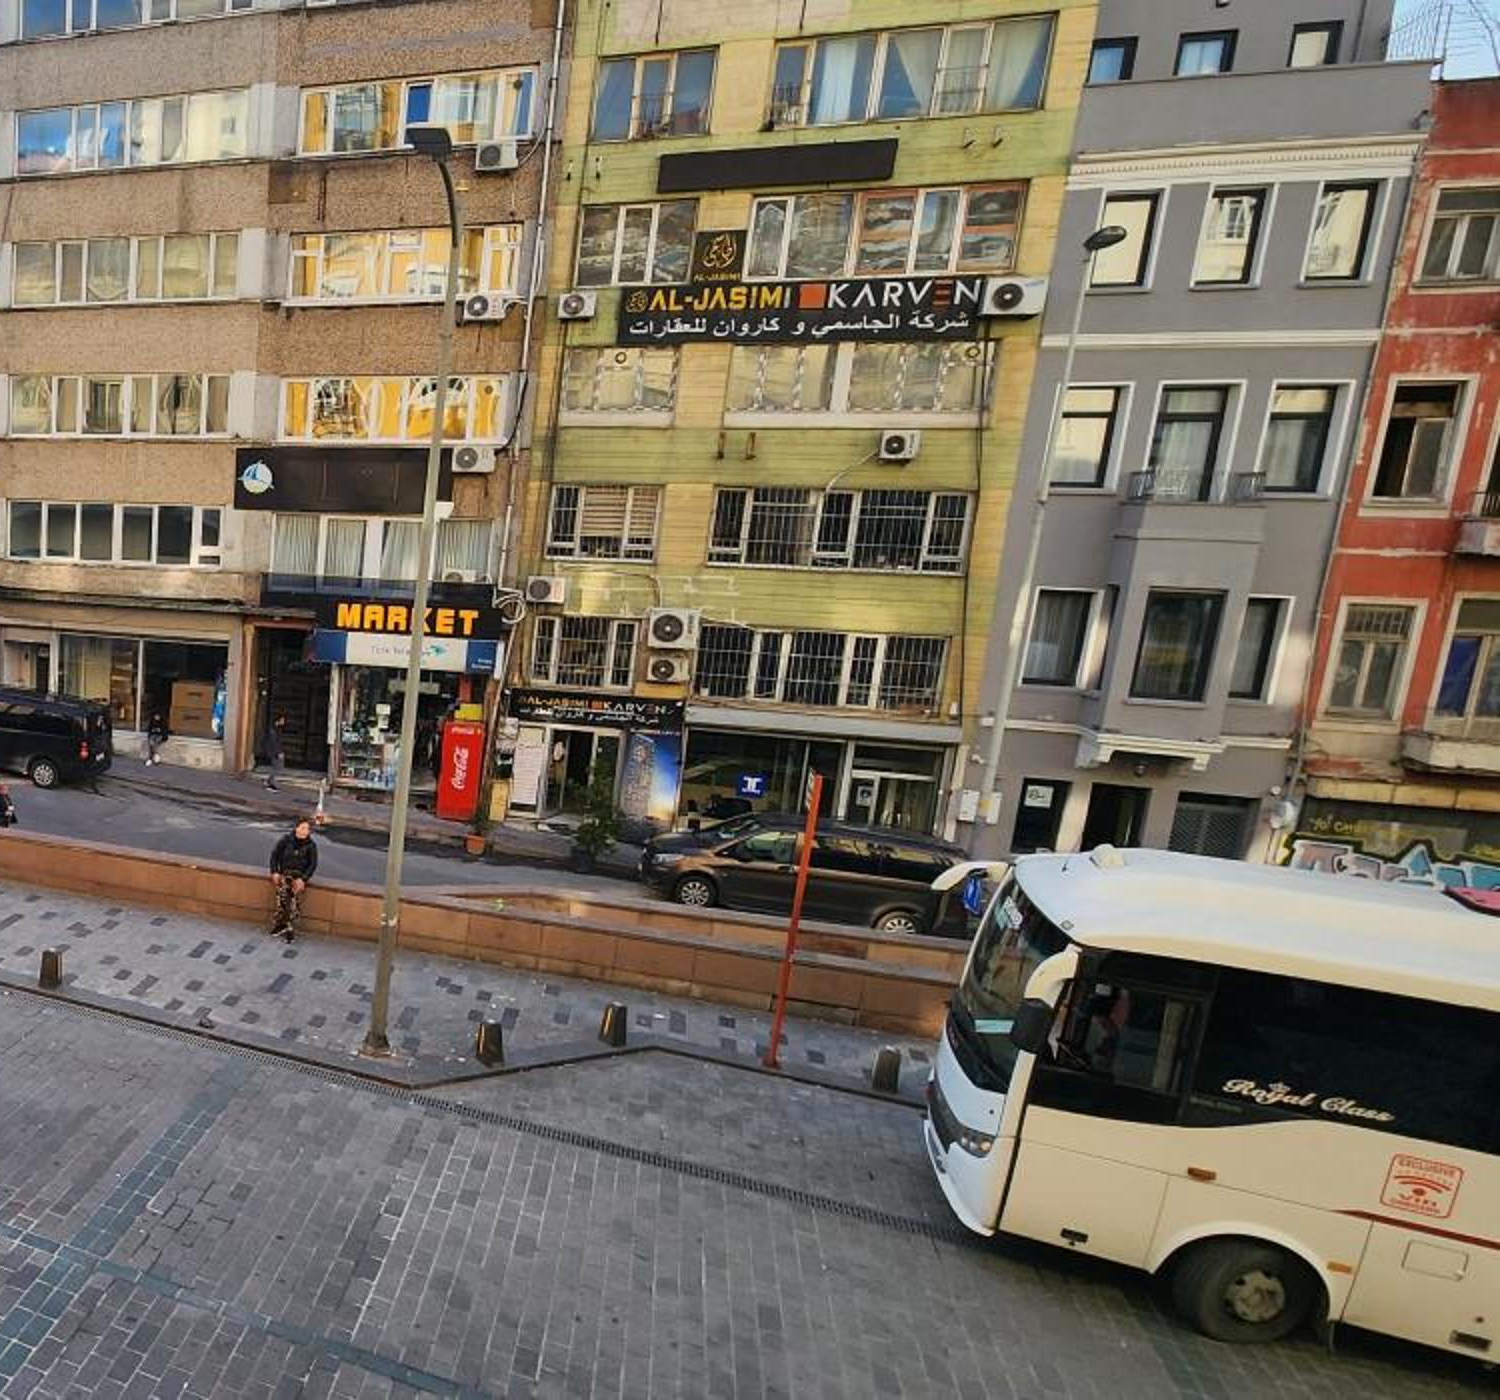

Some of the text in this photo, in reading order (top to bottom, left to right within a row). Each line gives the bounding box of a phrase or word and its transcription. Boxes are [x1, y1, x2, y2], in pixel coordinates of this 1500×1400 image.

[649, 279, 982, 312] AL-JASIMI KARVEN
[629, 309, 970, 339] شركة الجاسمي و كاروان للعقارات
[336, 603, 480, 636] MARKET
[603, 701, 667, 715] KARVEN
[1221, 1078, 1317, 1107] Royal
[1319, 1097, 1396, 1122] Class
